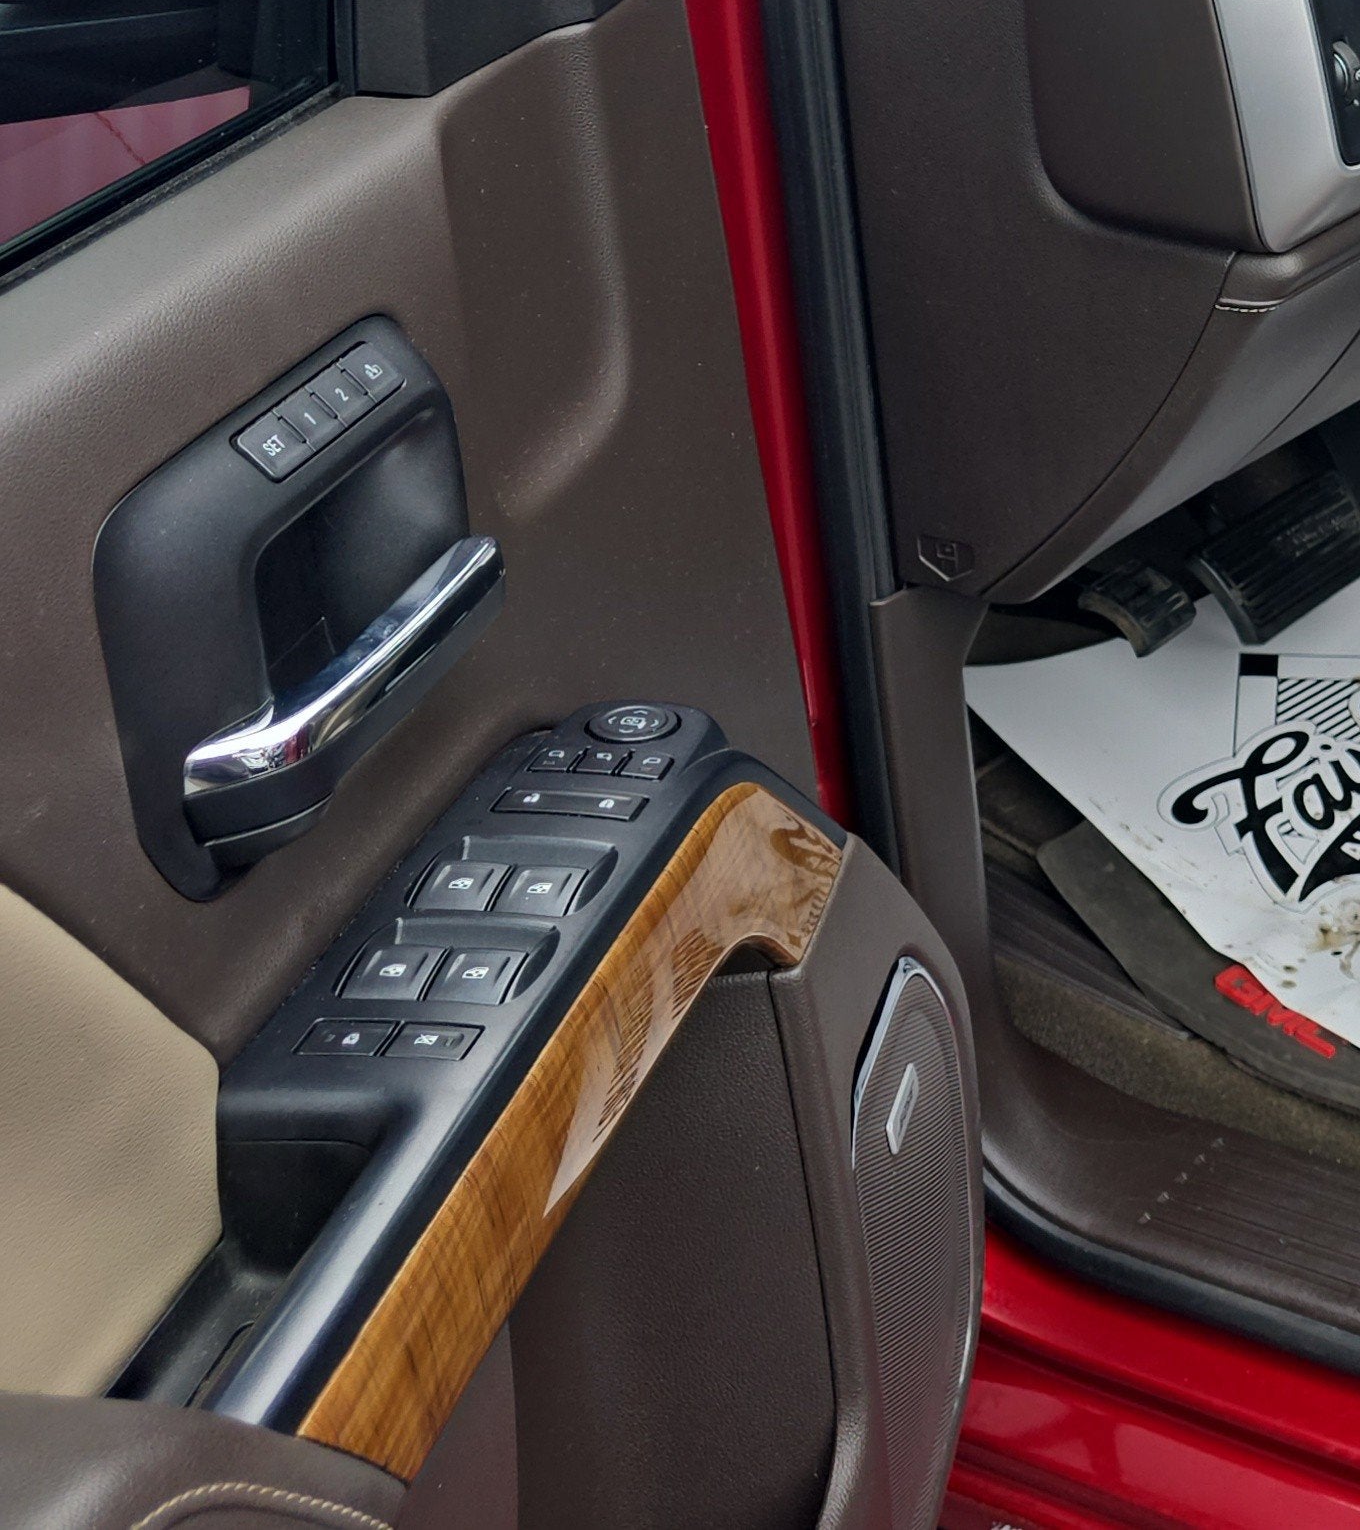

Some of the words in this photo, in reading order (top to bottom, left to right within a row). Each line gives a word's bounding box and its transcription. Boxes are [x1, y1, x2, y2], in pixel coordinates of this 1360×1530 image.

[262, 434, 286, 457] SET
[304, 412, 316, 425] 1
[334, 387, 349, 402] 2
